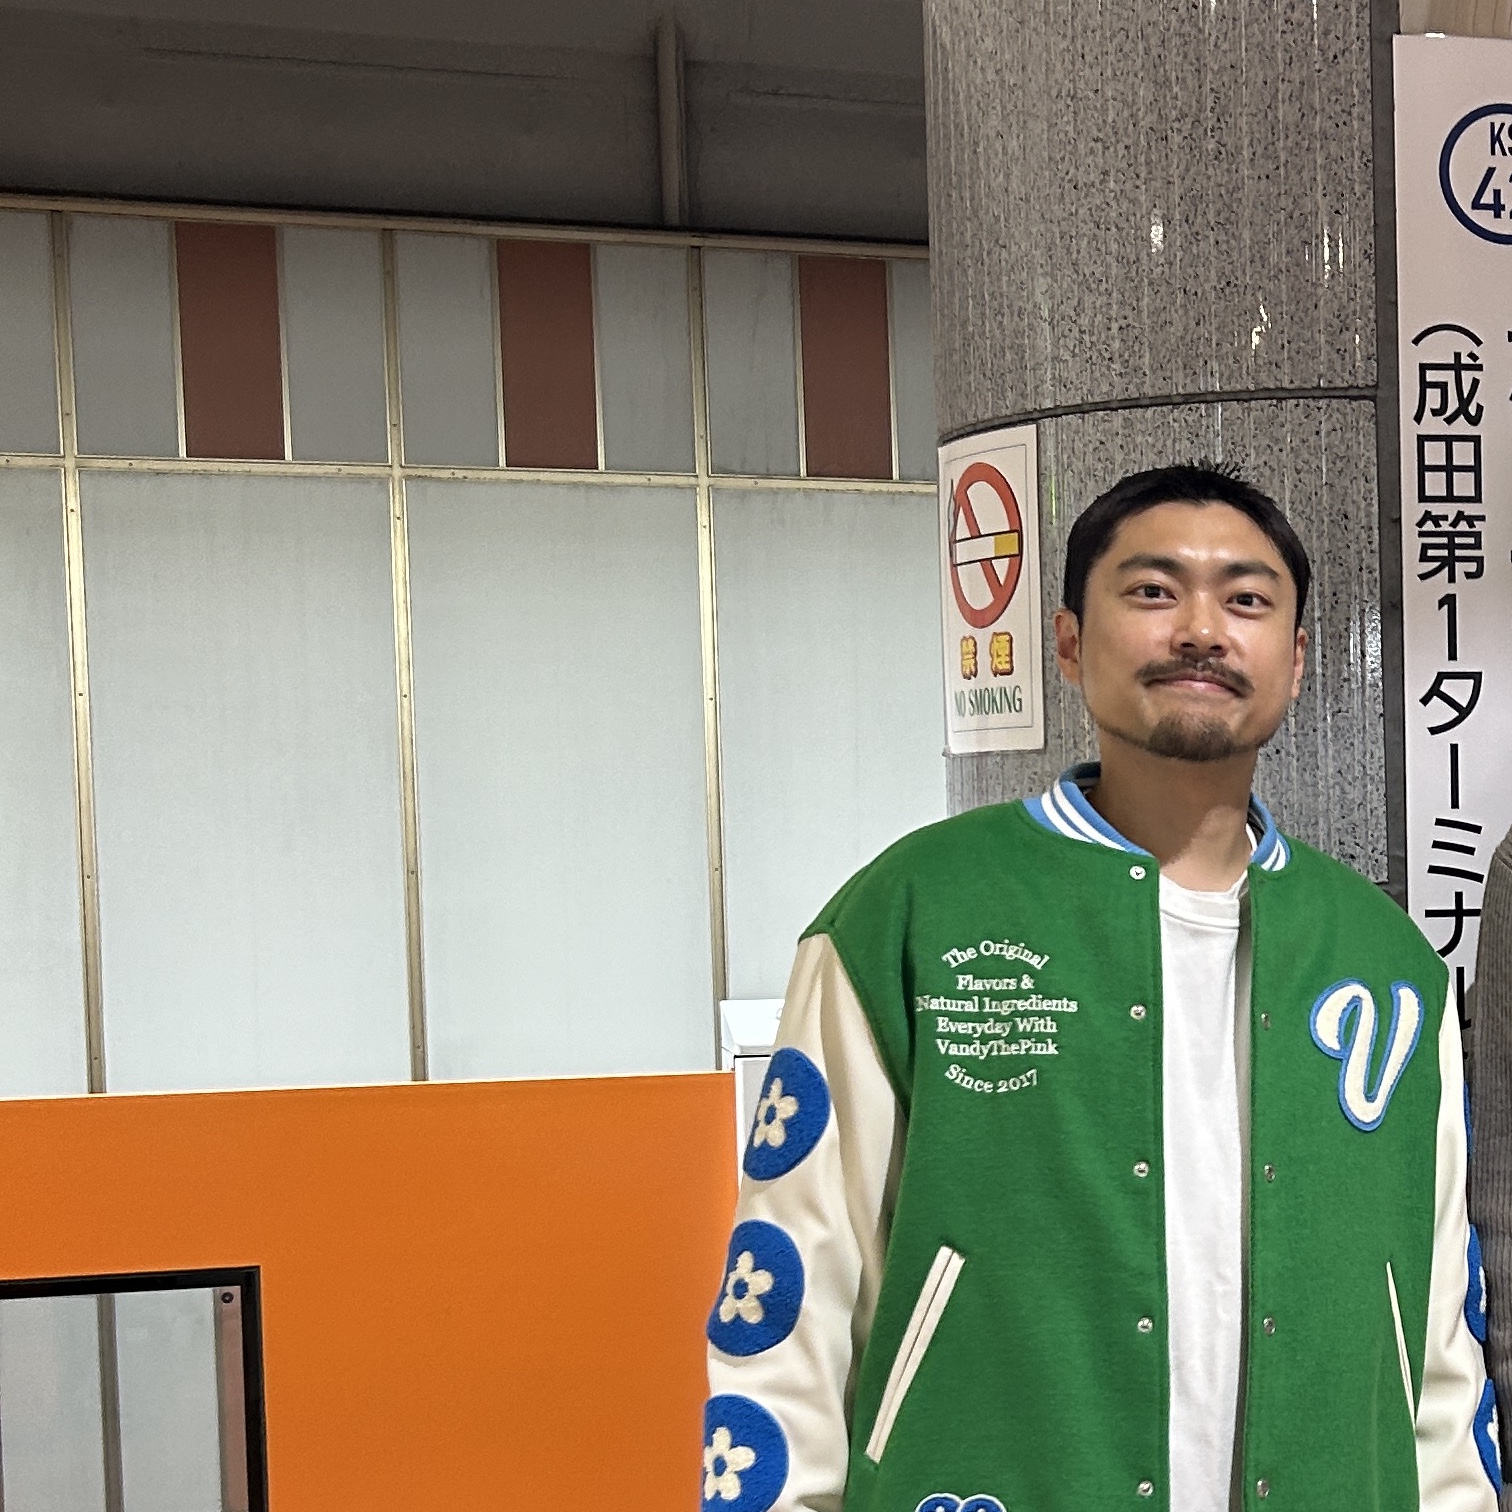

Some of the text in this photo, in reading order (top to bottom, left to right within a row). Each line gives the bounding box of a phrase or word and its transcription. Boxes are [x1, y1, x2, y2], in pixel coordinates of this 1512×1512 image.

[954, 685, 1023, 718] NO SMOKING
[941, 938, 1050, 970] The Original
[955, 974, 1035, 991] Flavors &
[915, 994, 1078, 1015] Natural Ingredients
[936, 1017, 1058, 1037] Everyday With
[936, 1038, 1058, 1060] VandyThePink
[944, 1063, 1038, 1093] Since 2017
